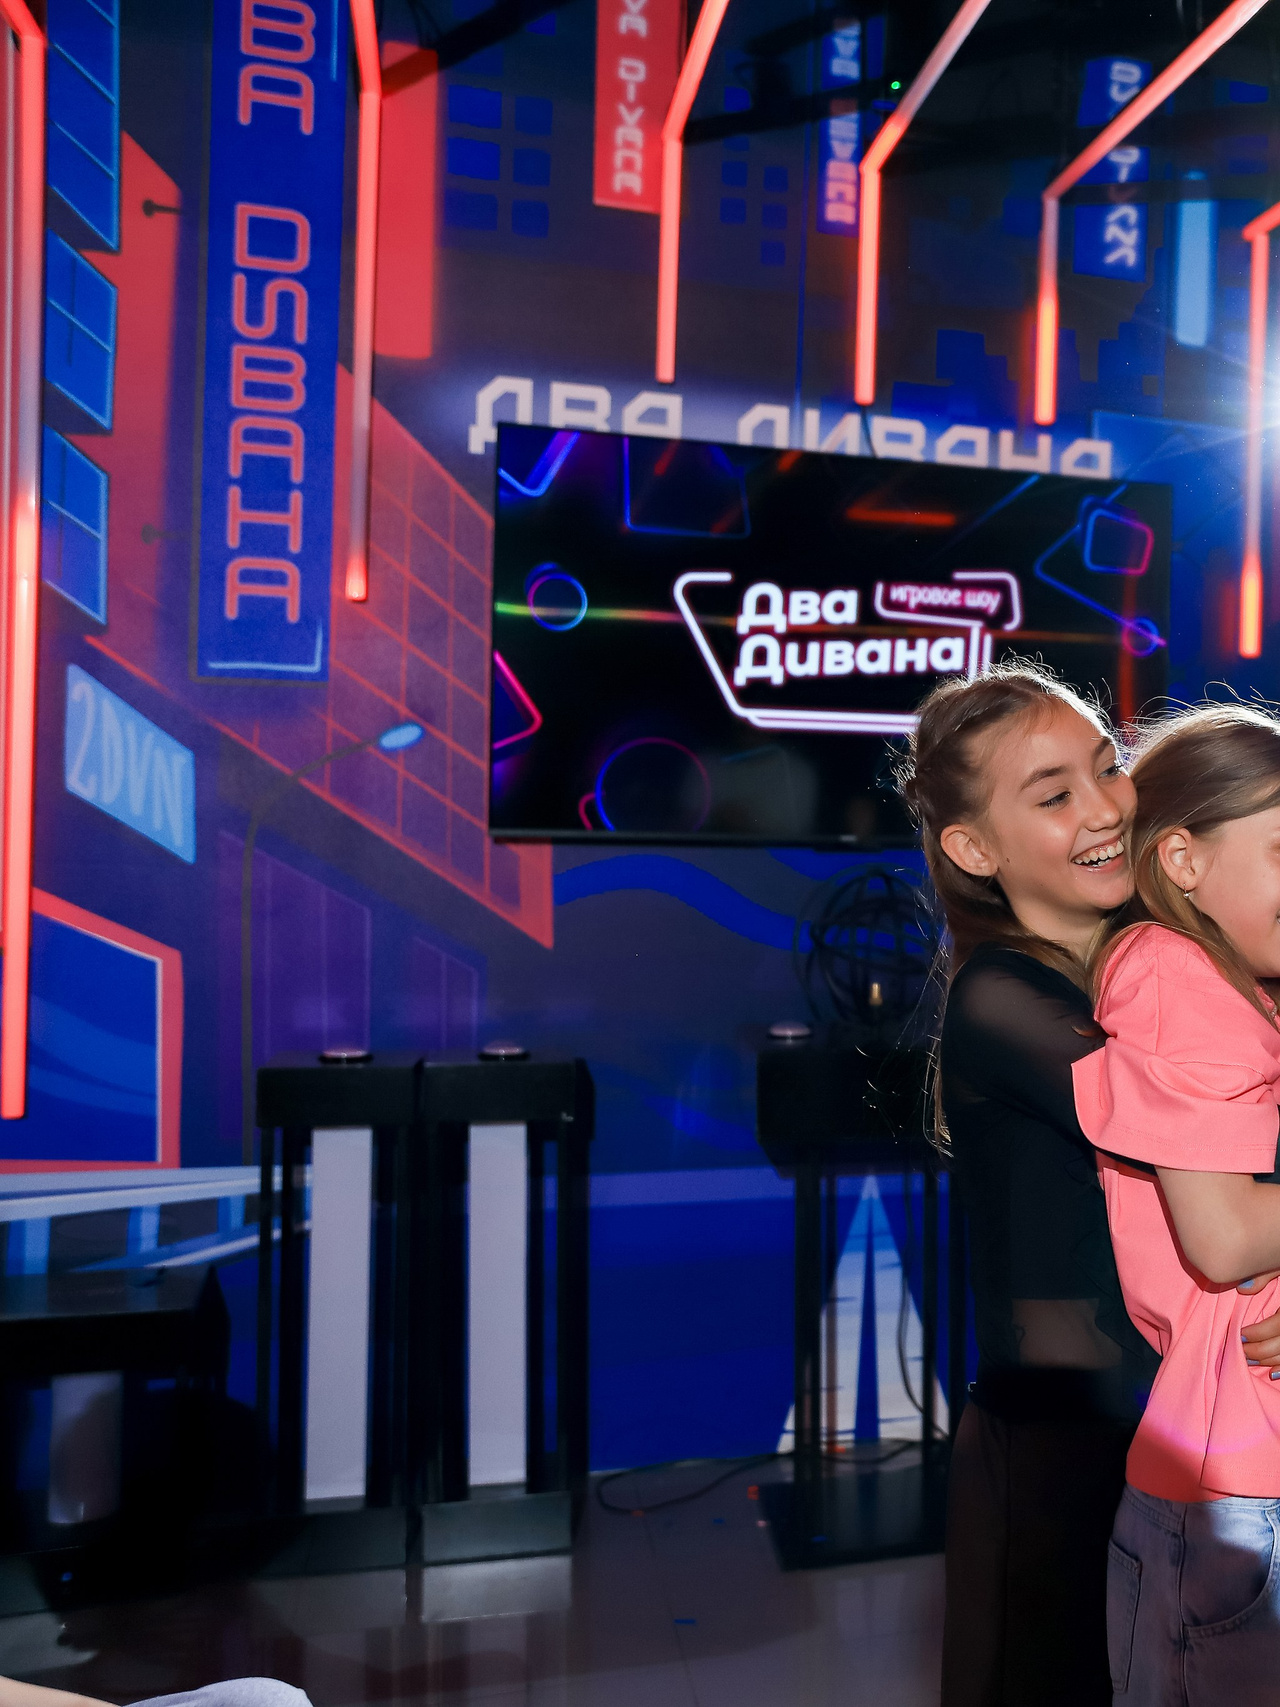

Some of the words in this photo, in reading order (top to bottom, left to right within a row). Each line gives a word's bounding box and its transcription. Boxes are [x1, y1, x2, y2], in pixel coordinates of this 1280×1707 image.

[736, 581, 859, 635] Два
[889, 584, 963, 610] игровое
[965, 588, 1002, 615] шоу
[733, 633, 965, 687] Дивана
